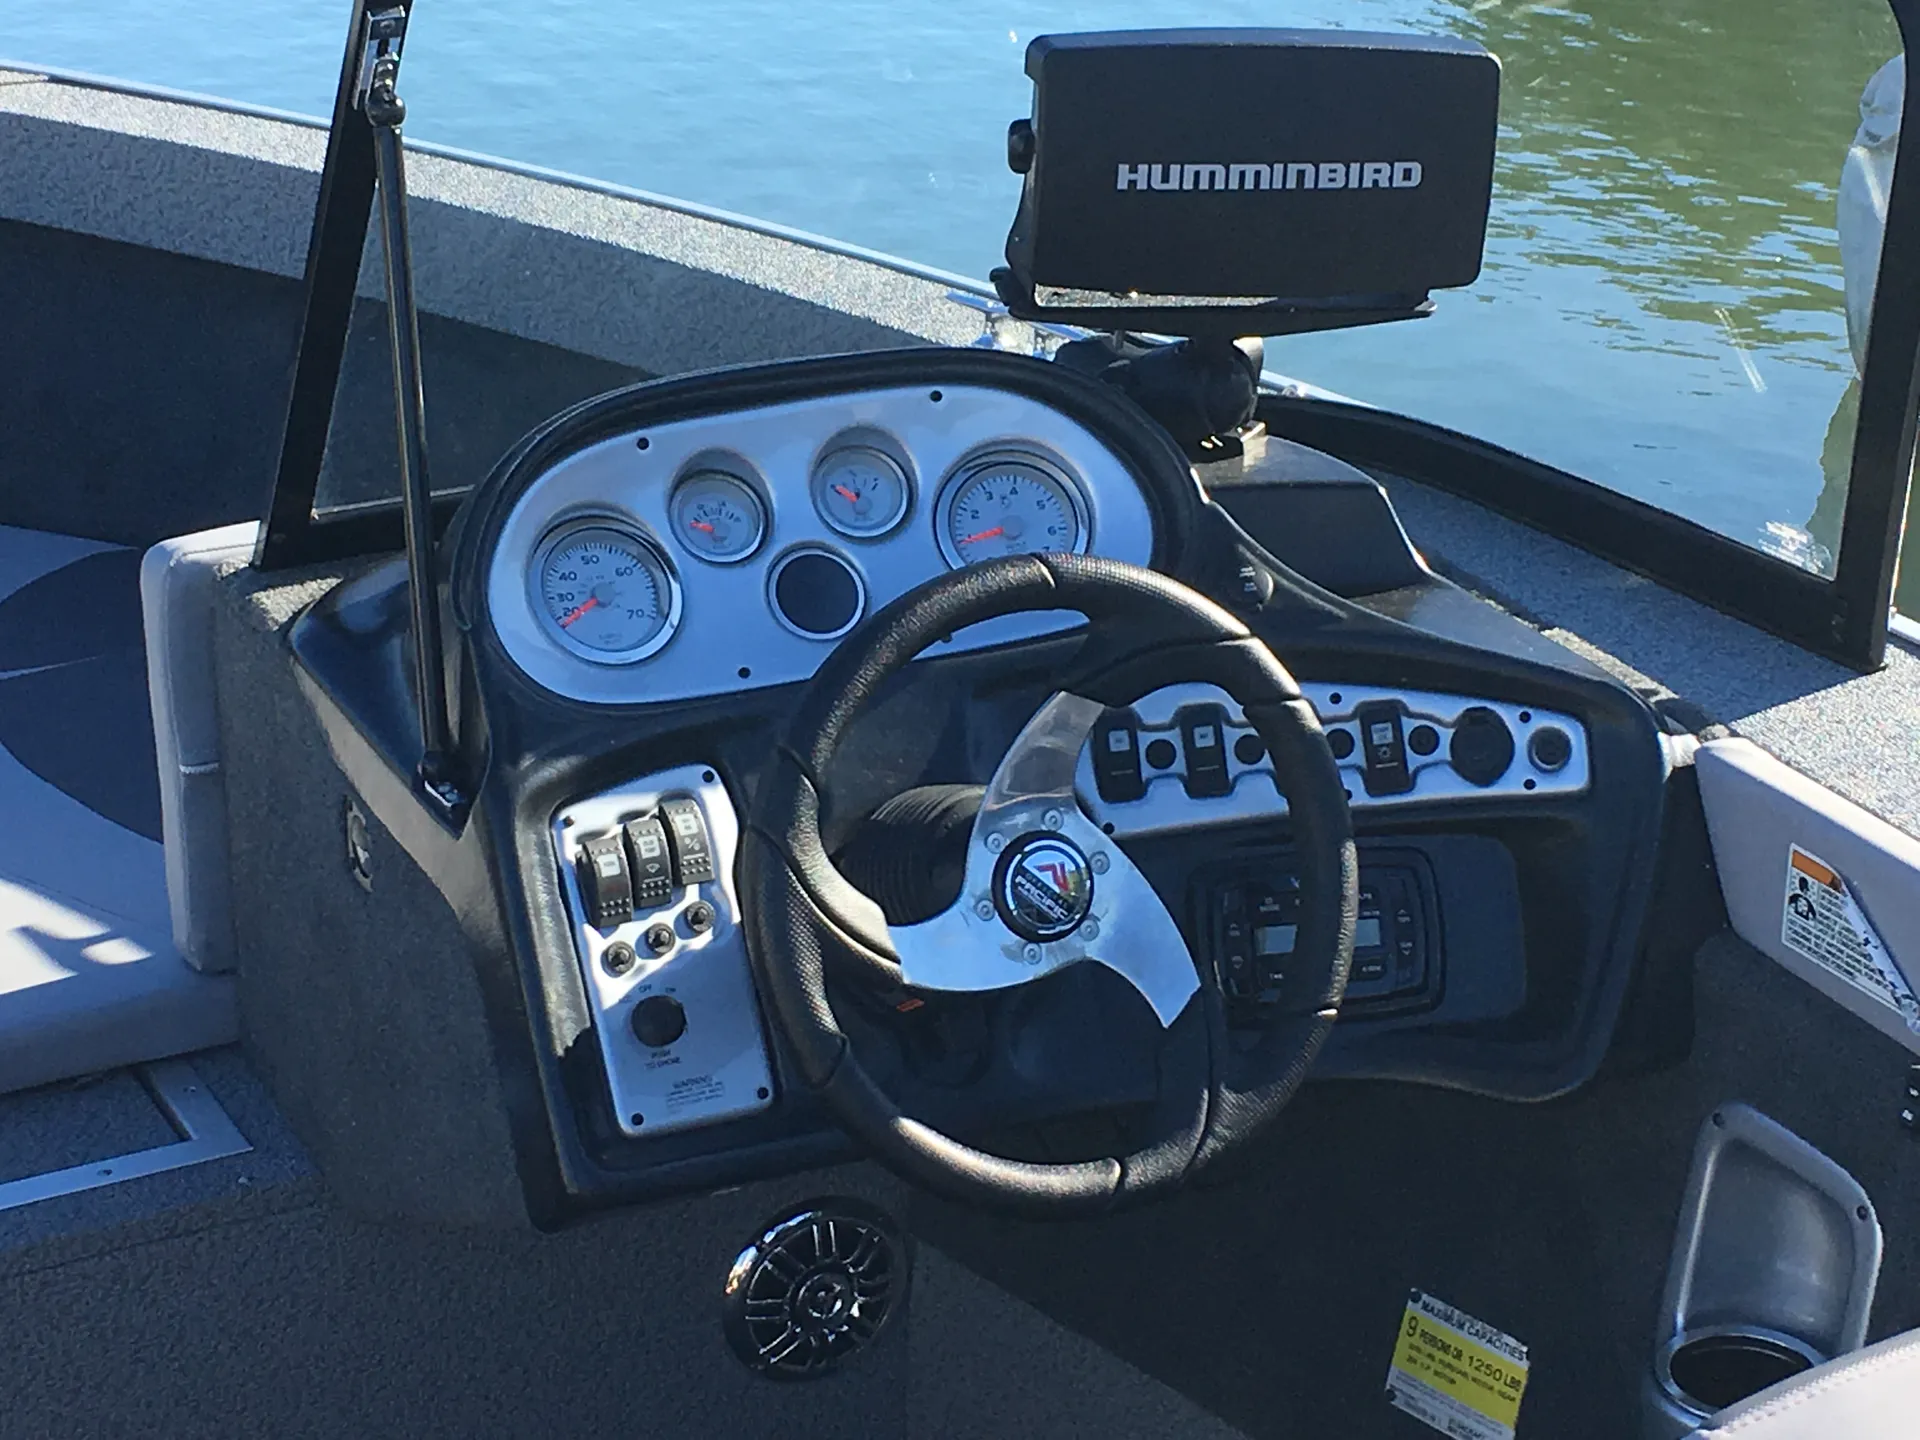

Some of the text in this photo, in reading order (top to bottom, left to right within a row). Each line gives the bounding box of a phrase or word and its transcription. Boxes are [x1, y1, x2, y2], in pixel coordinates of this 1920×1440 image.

[1116, 161, 1423, 191] HUMMINBIRD
[581, 554, 600, 565] 50
[559, 571, 577, 581] 40
[615, 567, 634, 577] 60
[557, 592, 575, 602] 30
[626, 608, 645, 620] 70
[1406, 1315, 1419, 1337] 9
[1468, 1356, 1503, 1381] 1250
[1466, 1324, 1525, 1361] CAPACITIES
